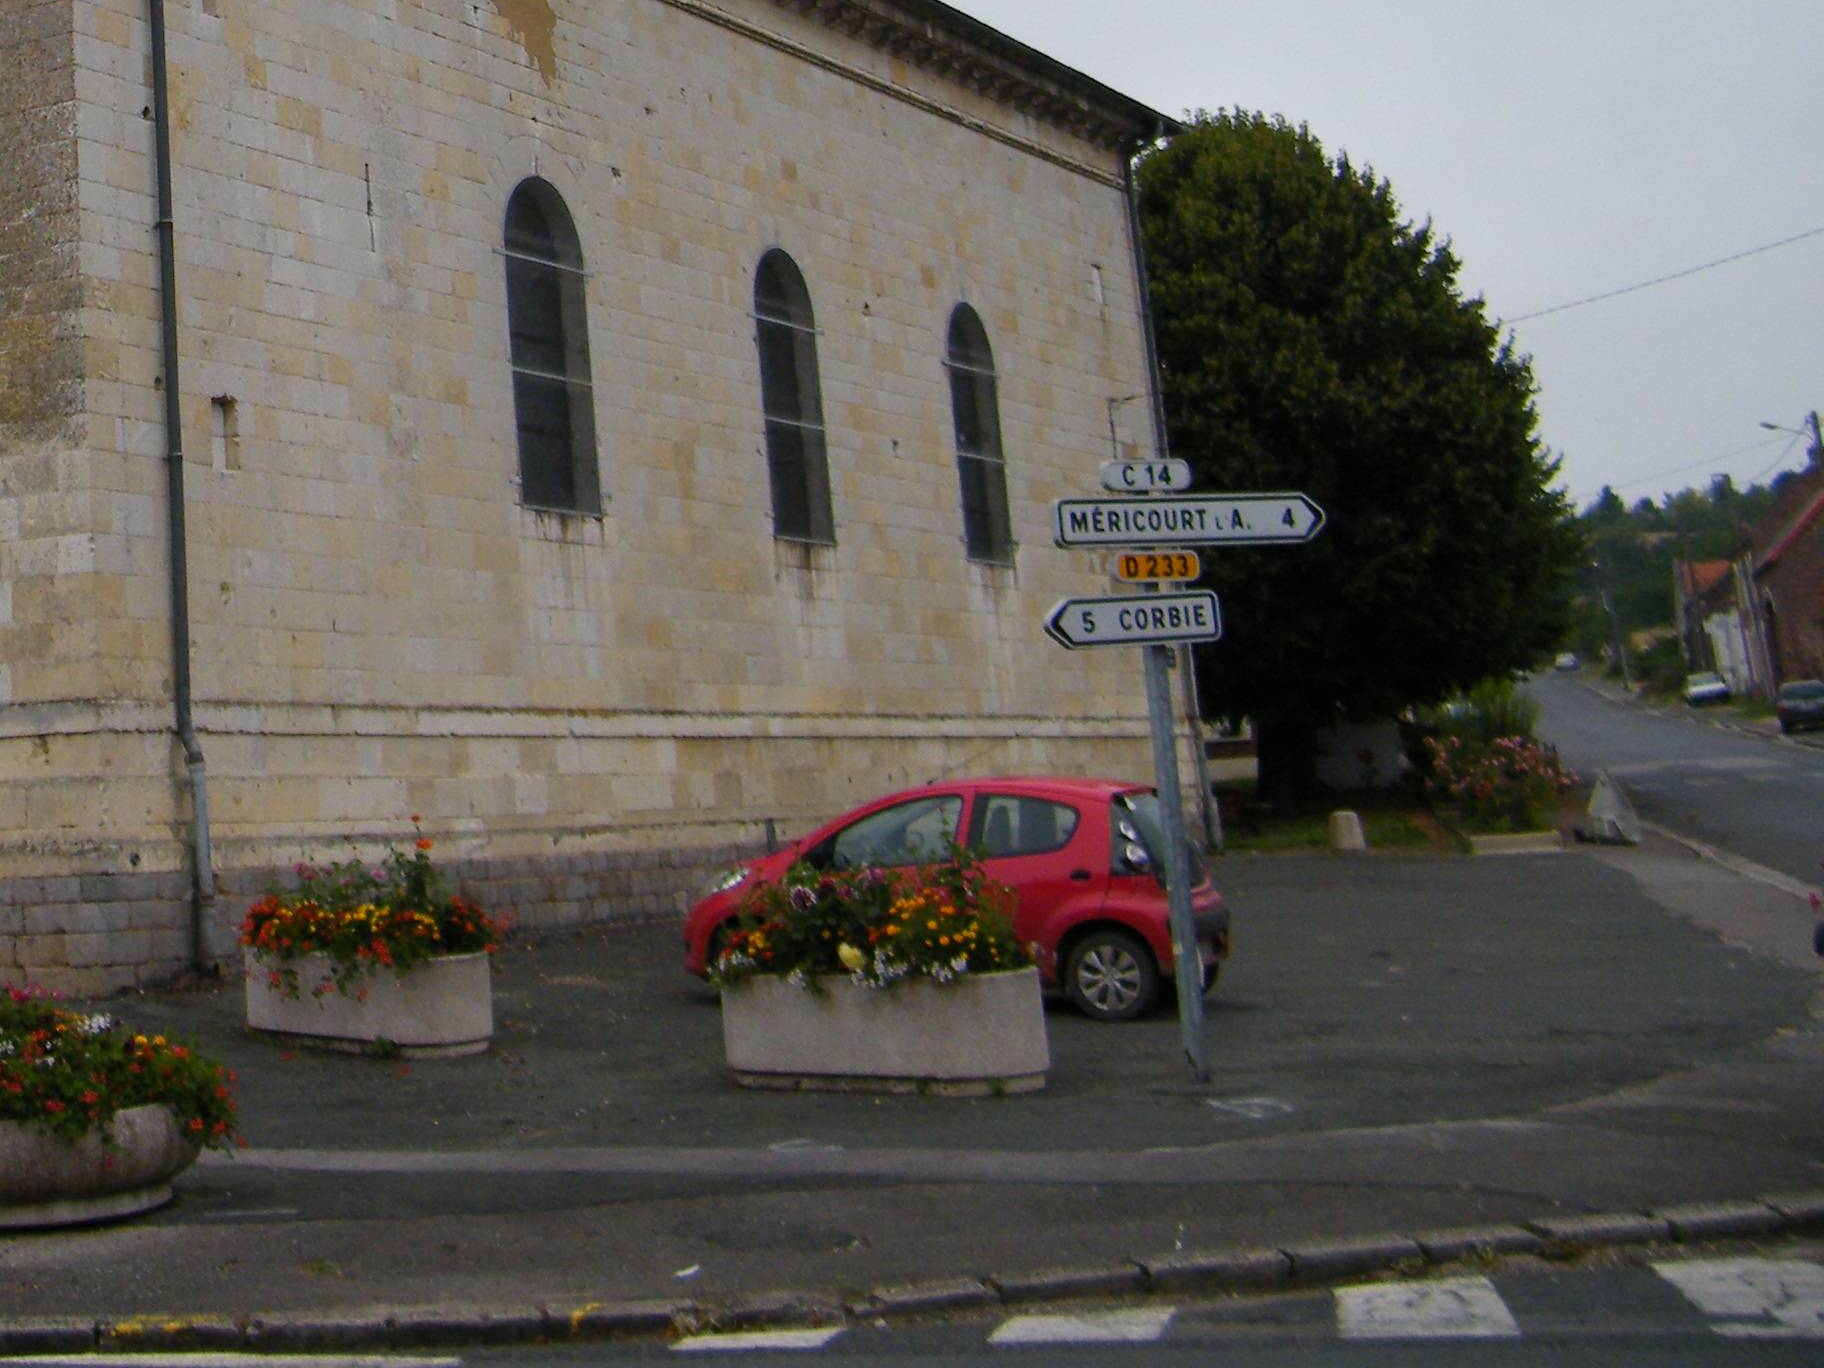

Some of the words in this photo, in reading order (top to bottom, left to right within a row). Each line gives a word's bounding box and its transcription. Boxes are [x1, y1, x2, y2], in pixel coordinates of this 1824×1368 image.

[1122, 464, 1136, 486] C
[1144, 464, 1172, 485] 14
[1070, 506, 1206, 532] MÉRICOURT
[1281, 507, 1296, 529] 4
[1125, 555, 1138, 578] D
[1146, 555, 1189, 577] 233
[1082, 611, 1096, 634] 5
[1119, 604, 1207, 631] CORBIE
